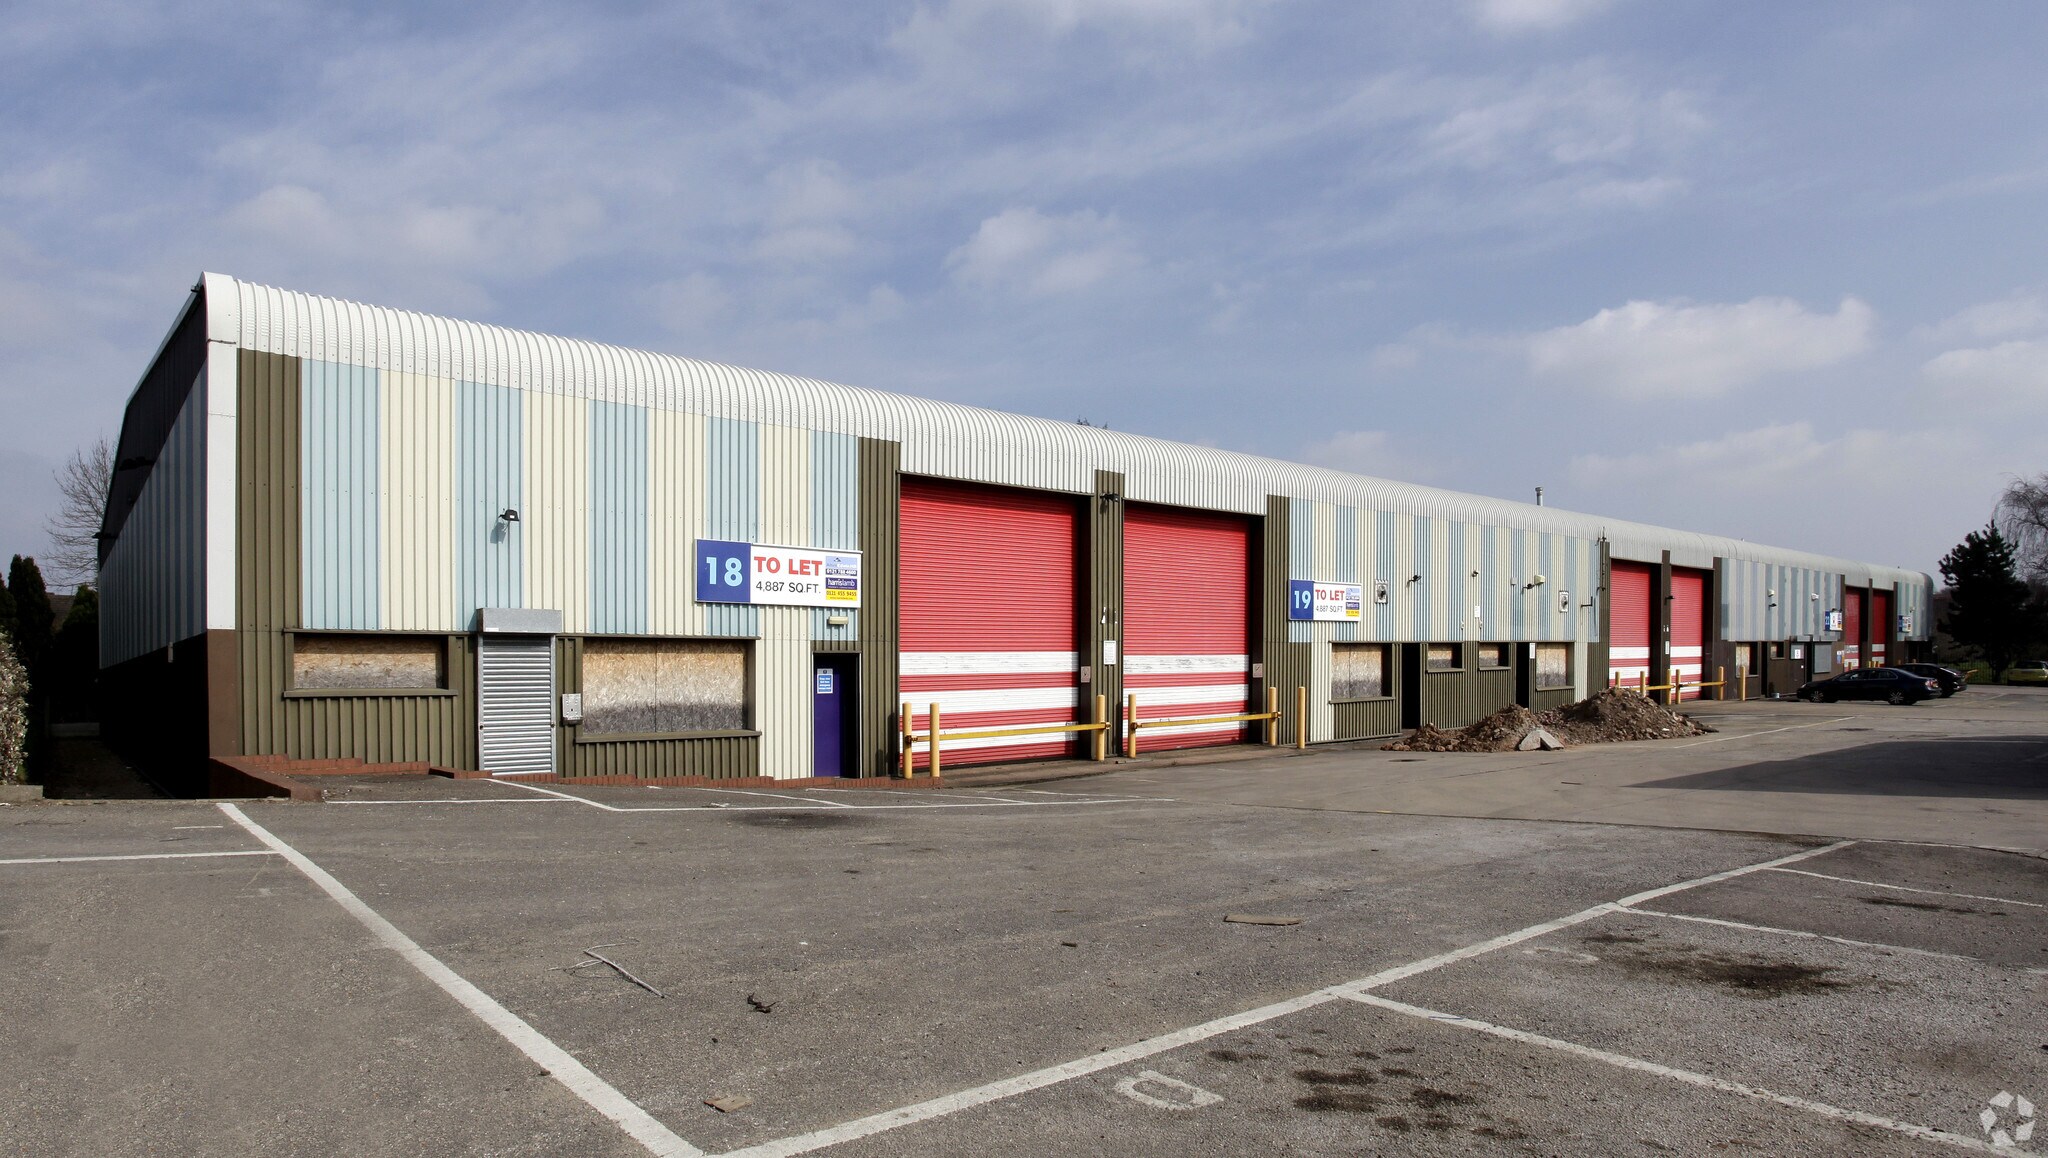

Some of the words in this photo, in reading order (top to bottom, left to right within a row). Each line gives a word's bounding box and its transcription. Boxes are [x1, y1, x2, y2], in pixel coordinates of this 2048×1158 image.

[706, 556, 743, 587] 18
[754, 556, 780, 574] TO
[788, 558, 823, 577] LET
[755, 581, 785, 593] 4,887
[788, 582, 821, 594] SQ.FT.
[1315, 589, 1327, 601] TO
[1329, 590, 1345, 601] LET
[1294, 590, 1311, 609] 19
